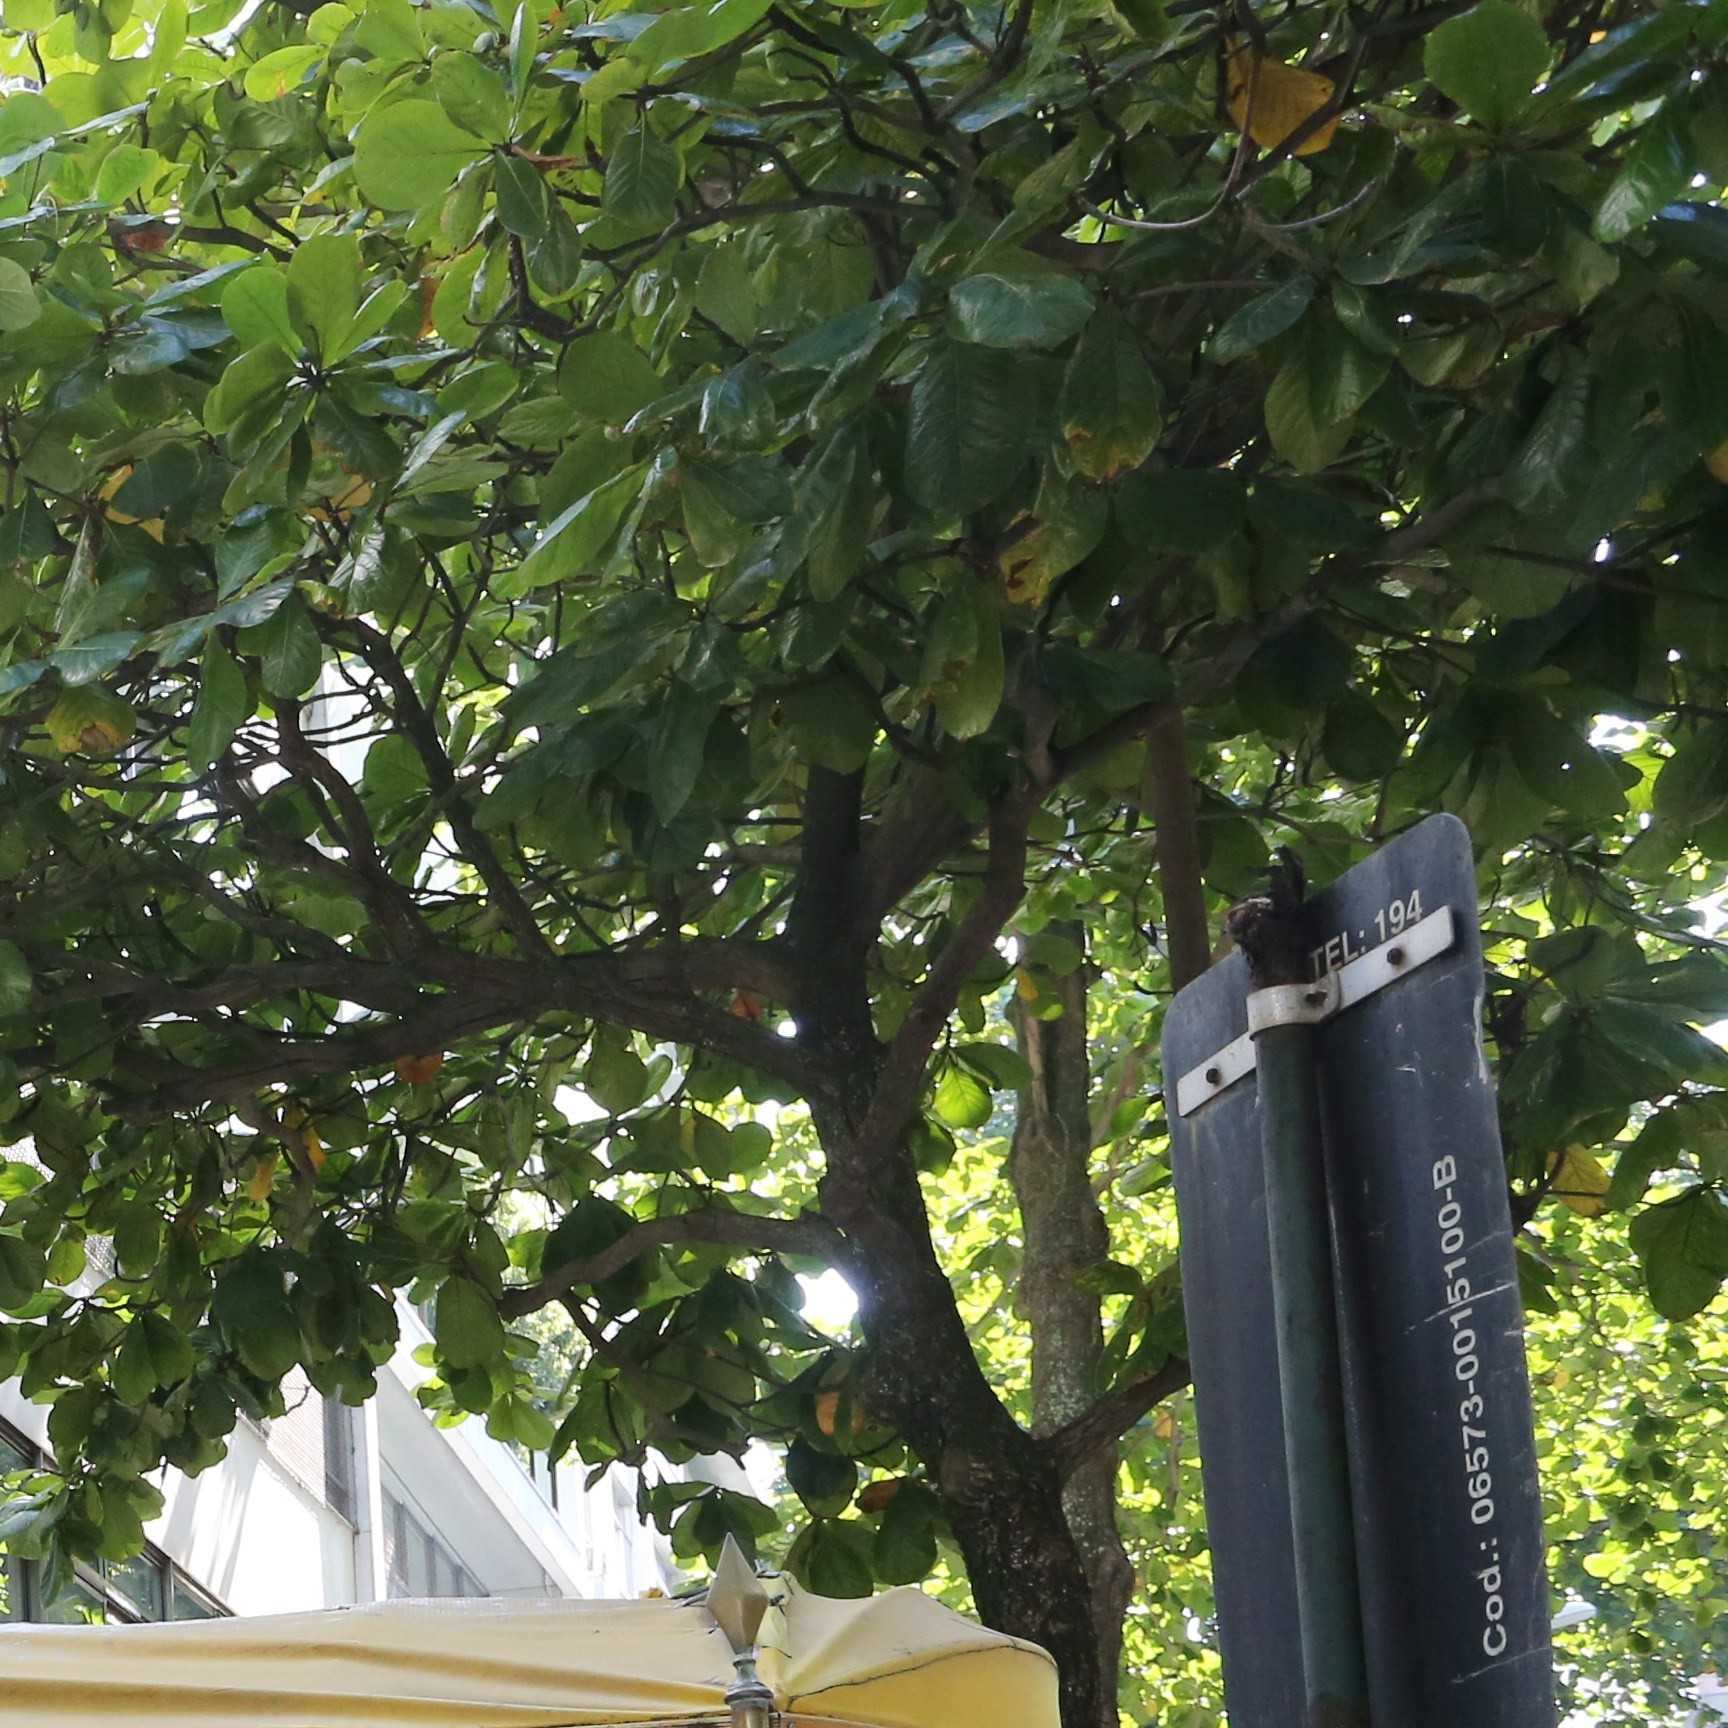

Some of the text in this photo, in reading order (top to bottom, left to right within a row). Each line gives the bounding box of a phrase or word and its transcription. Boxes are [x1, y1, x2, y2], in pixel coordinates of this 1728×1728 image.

[1374, 889, 1423, 942] 194
[1433, 1154, 1507, 1657] Cod.: 06573-0015100-B
